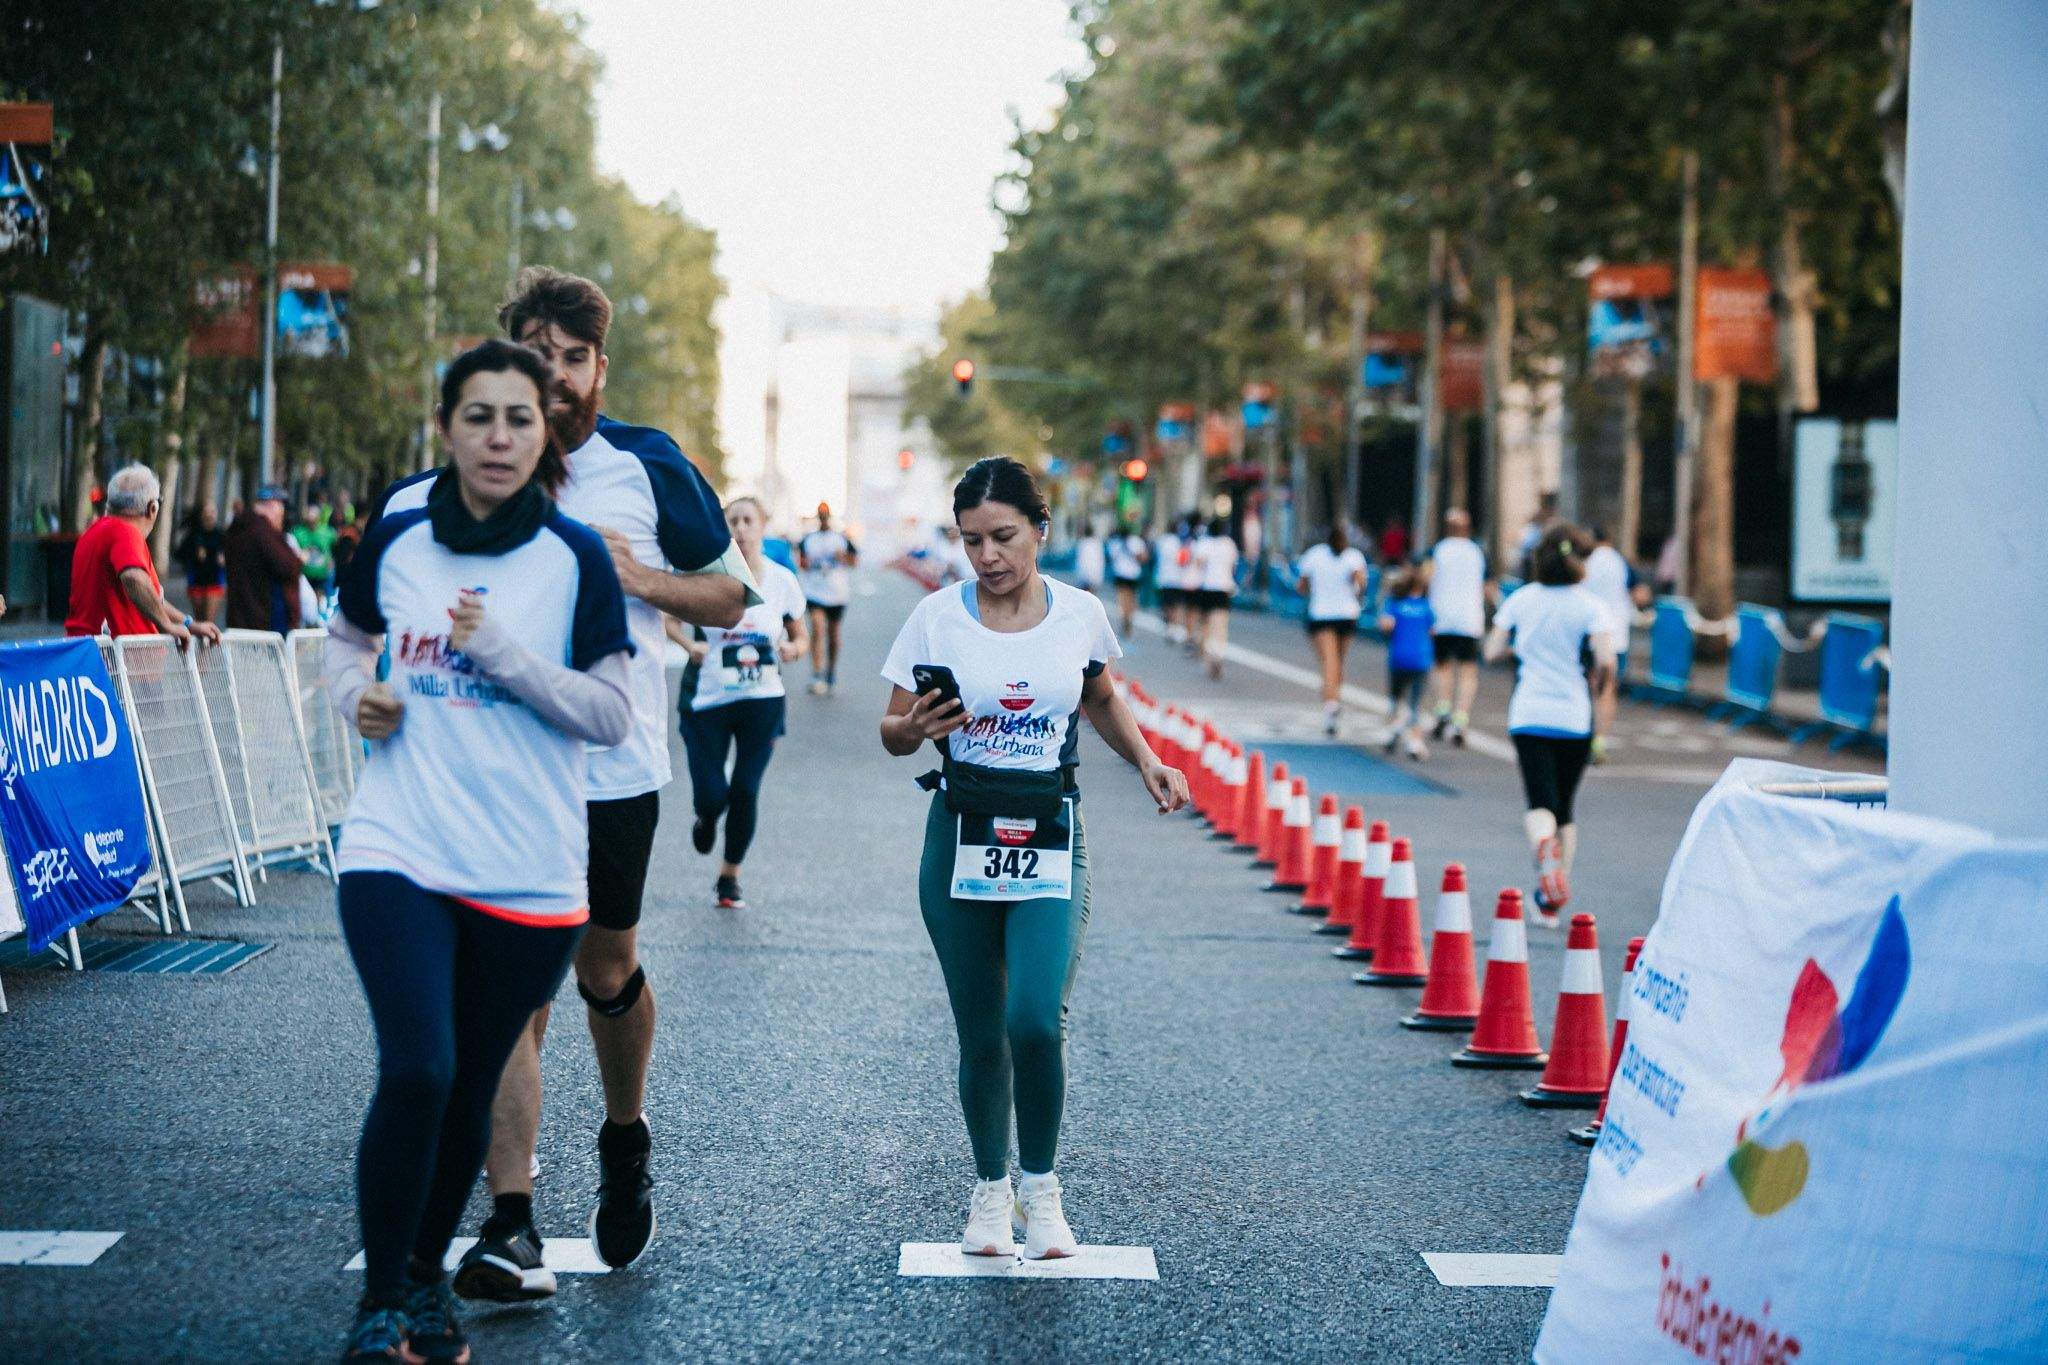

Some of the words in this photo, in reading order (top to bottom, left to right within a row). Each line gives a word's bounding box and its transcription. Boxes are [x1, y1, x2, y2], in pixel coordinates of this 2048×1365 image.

[408, 674, 448, 698] Milla
[8, 676, 117, 775] MADRID
[992, 735, 1045, 756] Urbana
[984, 847, 1039, 879] 342
